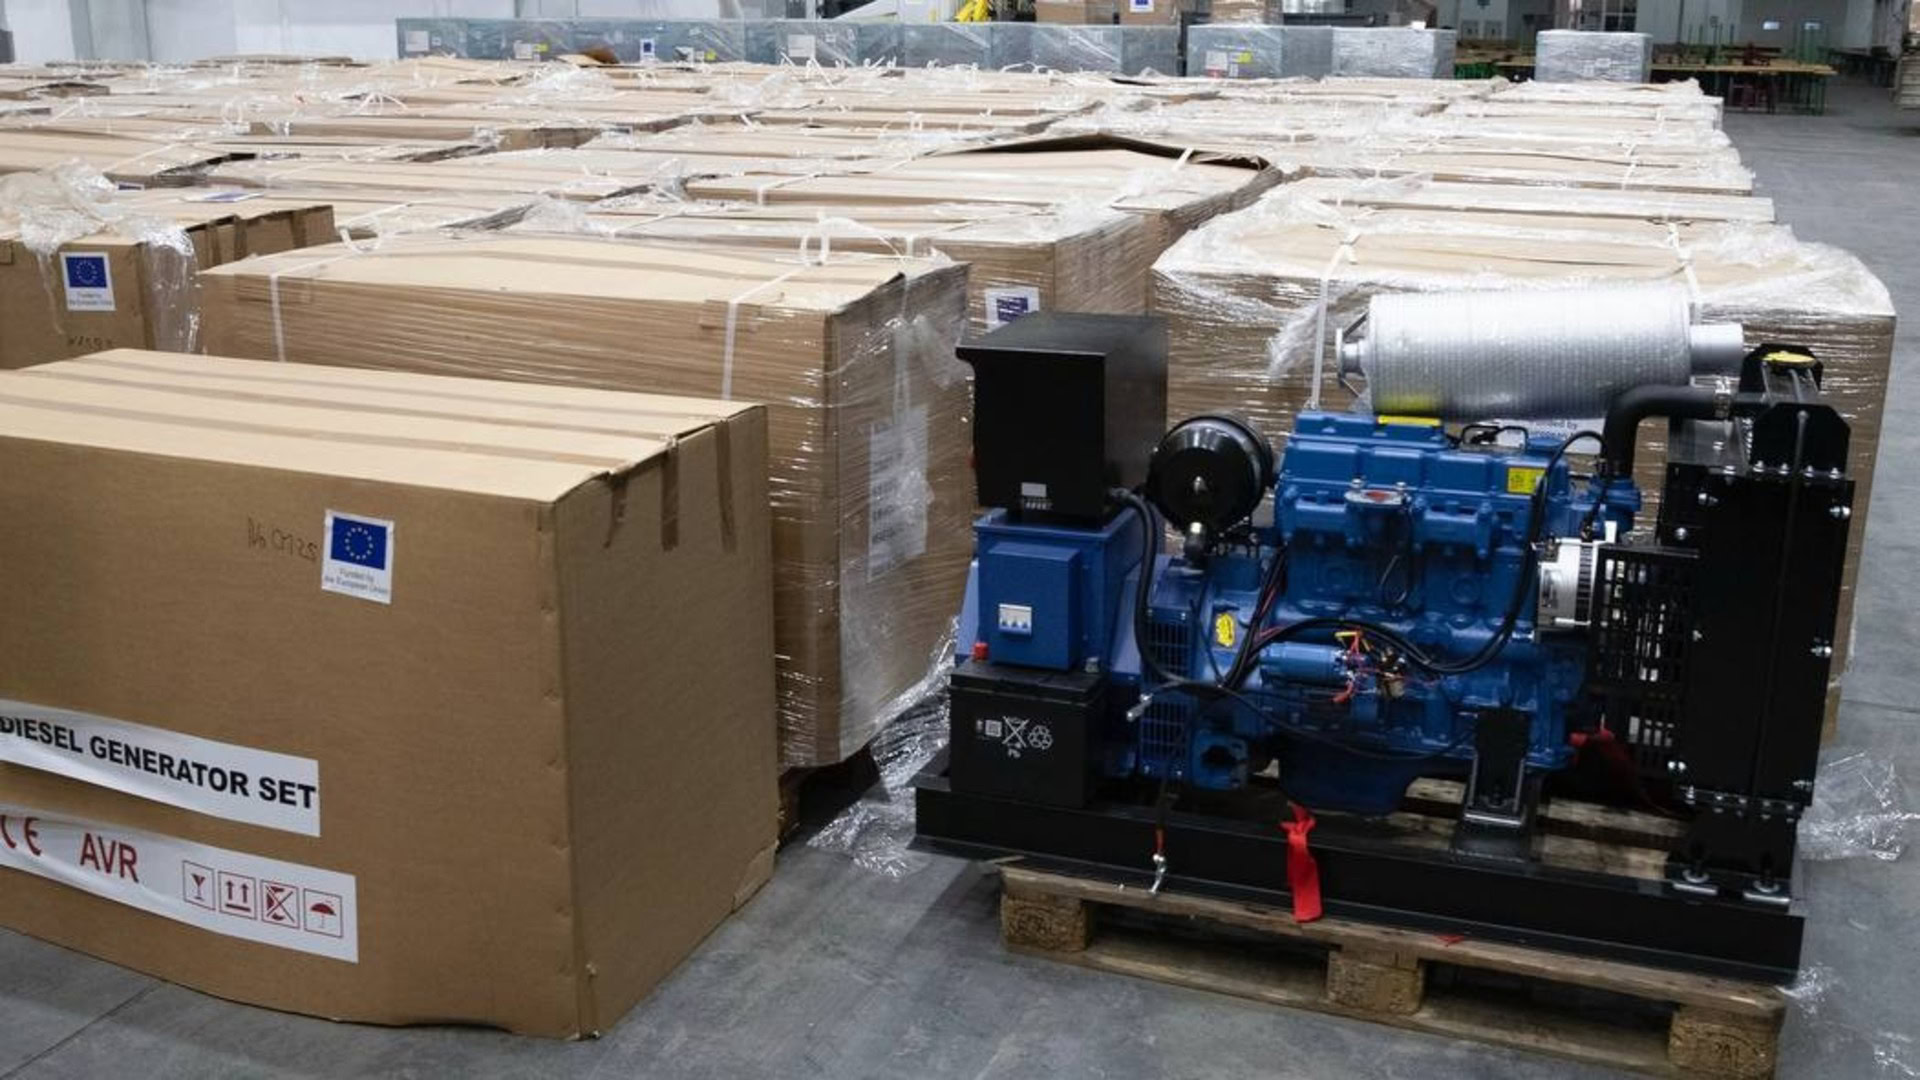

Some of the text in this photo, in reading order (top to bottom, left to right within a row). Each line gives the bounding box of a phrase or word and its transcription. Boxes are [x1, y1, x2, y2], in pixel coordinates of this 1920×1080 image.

[0, 715, 316, 809] DIESEL GENERATOR SET
[80, 832, 139, 884] AVR
